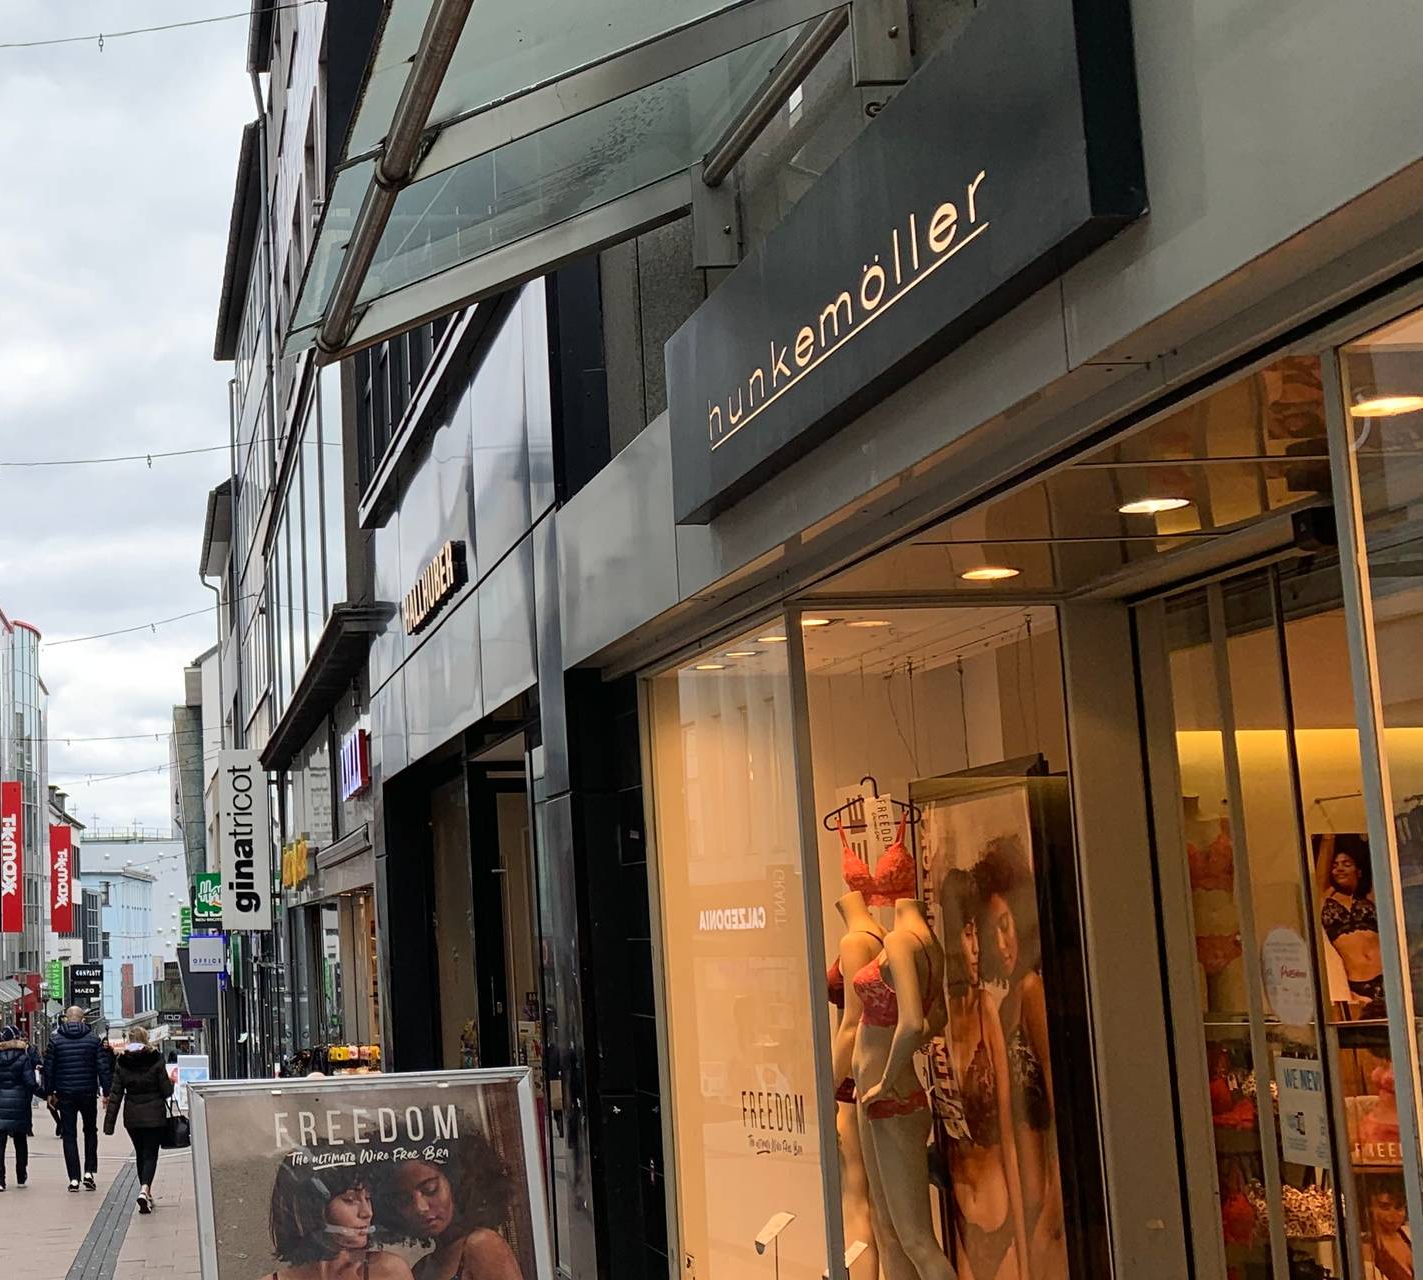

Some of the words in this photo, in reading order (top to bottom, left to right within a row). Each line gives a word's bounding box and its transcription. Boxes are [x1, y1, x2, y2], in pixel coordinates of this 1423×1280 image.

[706, 170, 987, 442] hunkemöller
[401, 540, 455, 635] HALLHUBER
[274, 1104, 459, 1148] FREEDOM
[741, 1091, 806, 1135] FREEDOM
